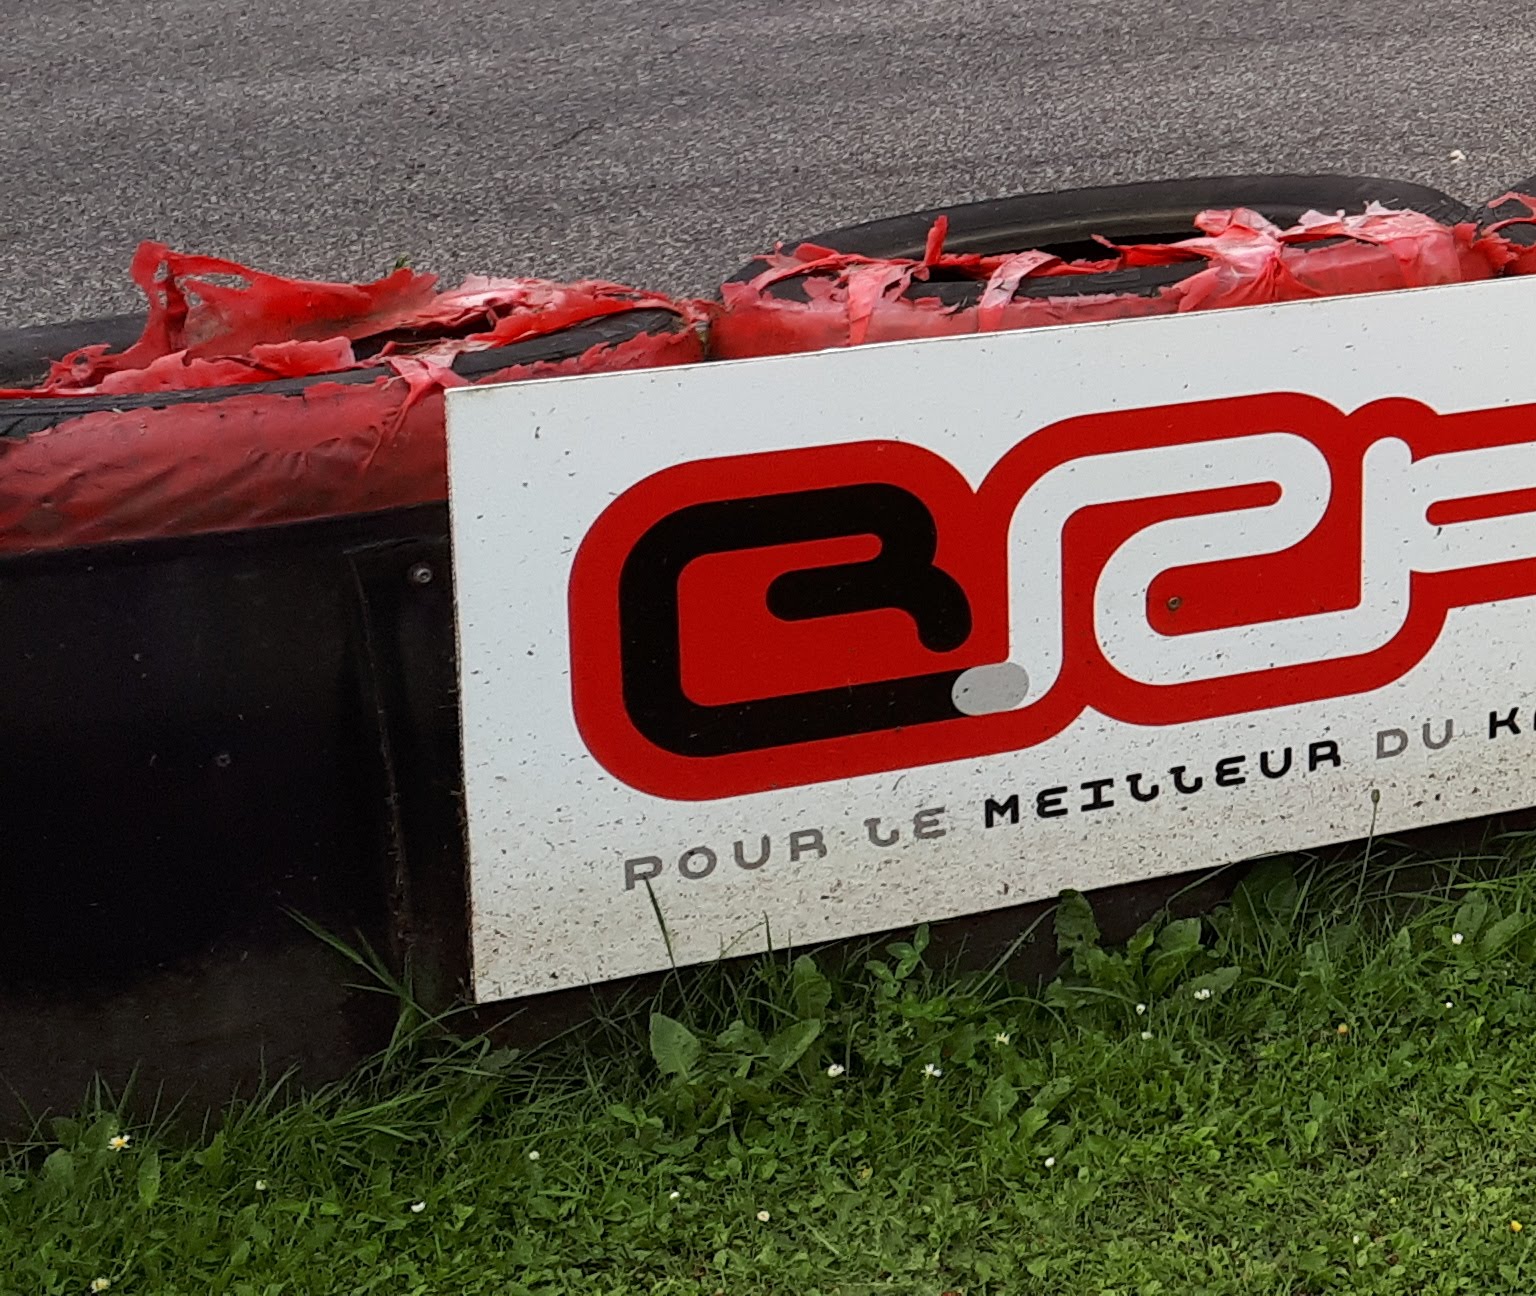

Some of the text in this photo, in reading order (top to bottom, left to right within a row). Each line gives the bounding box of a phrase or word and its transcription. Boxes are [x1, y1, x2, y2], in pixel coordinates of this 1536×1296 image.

[622, 825, 828, 892] POUR
[863, 805, 949, 849] LE
[983, 739, 1342, 830] MEILLEUR
[1375, 718, 1455, 762] DU
